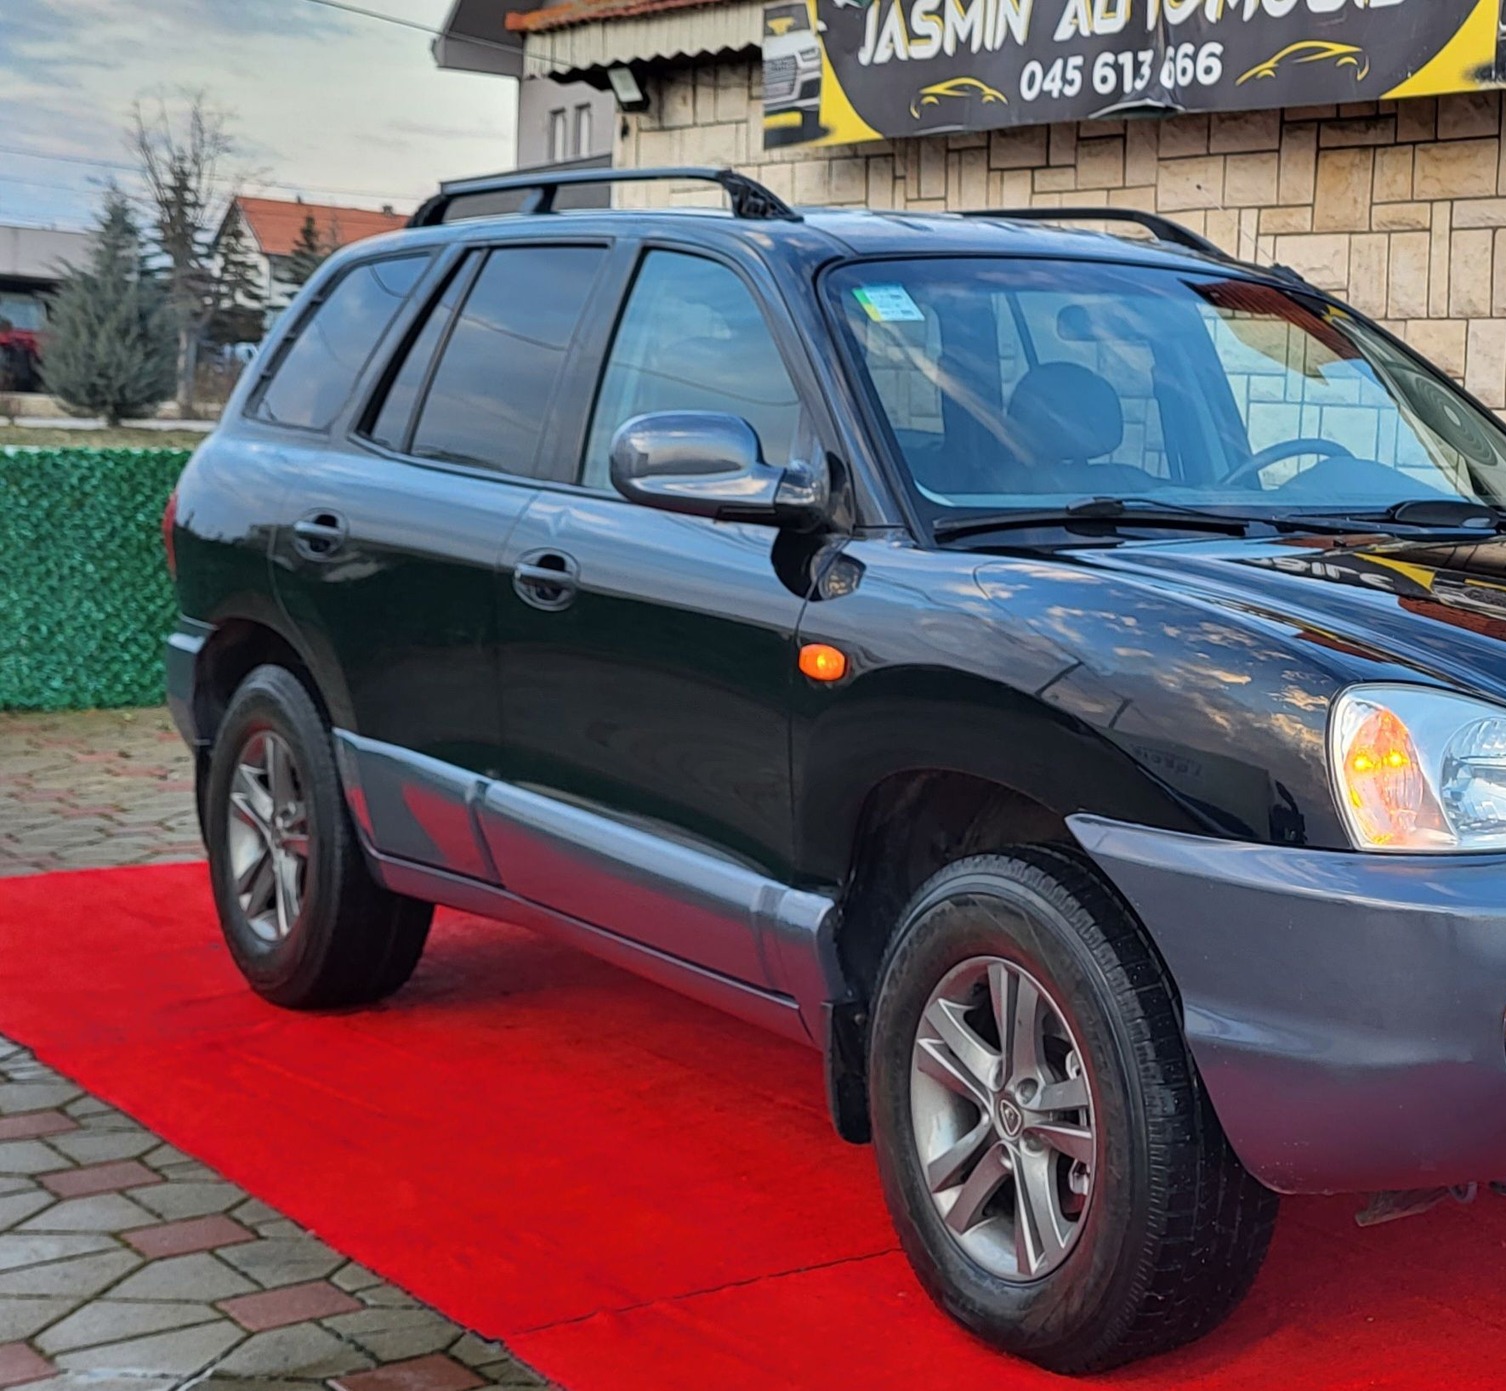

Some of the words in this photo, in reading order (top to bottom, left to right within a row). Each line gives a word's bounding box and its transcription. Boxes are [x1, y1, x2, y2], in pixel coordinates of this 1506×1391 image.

[858, 0, 1034, 66] JASMIN
[1019, 56, 1085, 101] 045
[1092, 50, 1154, 95] 613
[1159, 42, 1224, 90] 666
